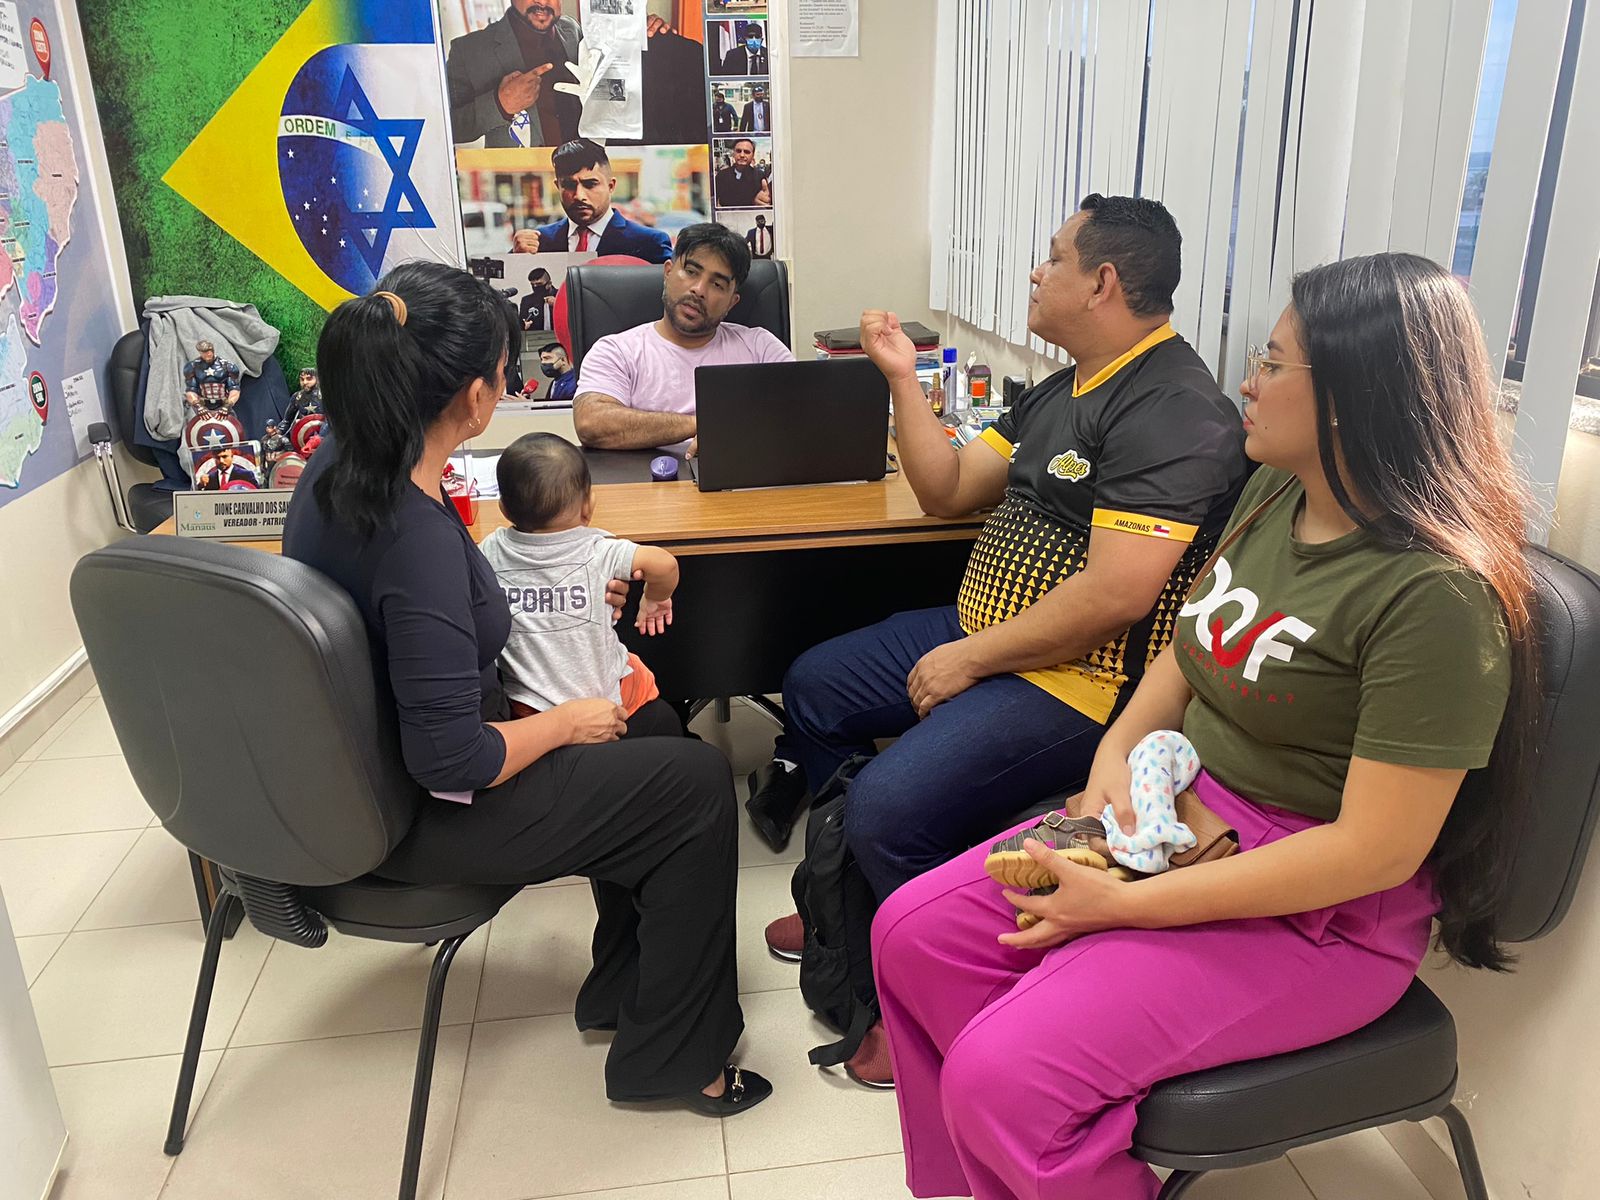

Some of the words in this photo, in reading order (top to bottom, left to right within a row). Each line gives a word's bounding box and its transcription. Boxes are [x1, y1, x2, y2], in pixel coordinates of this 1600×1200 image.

[284, 118, 336, 138] ORDEM
[214, 503, 233, 516] DIONE
[234, 502, 264, 515] CARVALHO
[265, 501, 278, 514] DOS
[180, 523, 216, 532] Manaus
[223, 518, 258, 528] VEREADOR
[1114, 519, 1151, 532] AMAZONAS
[501, 585, 587, 613] PORTS
